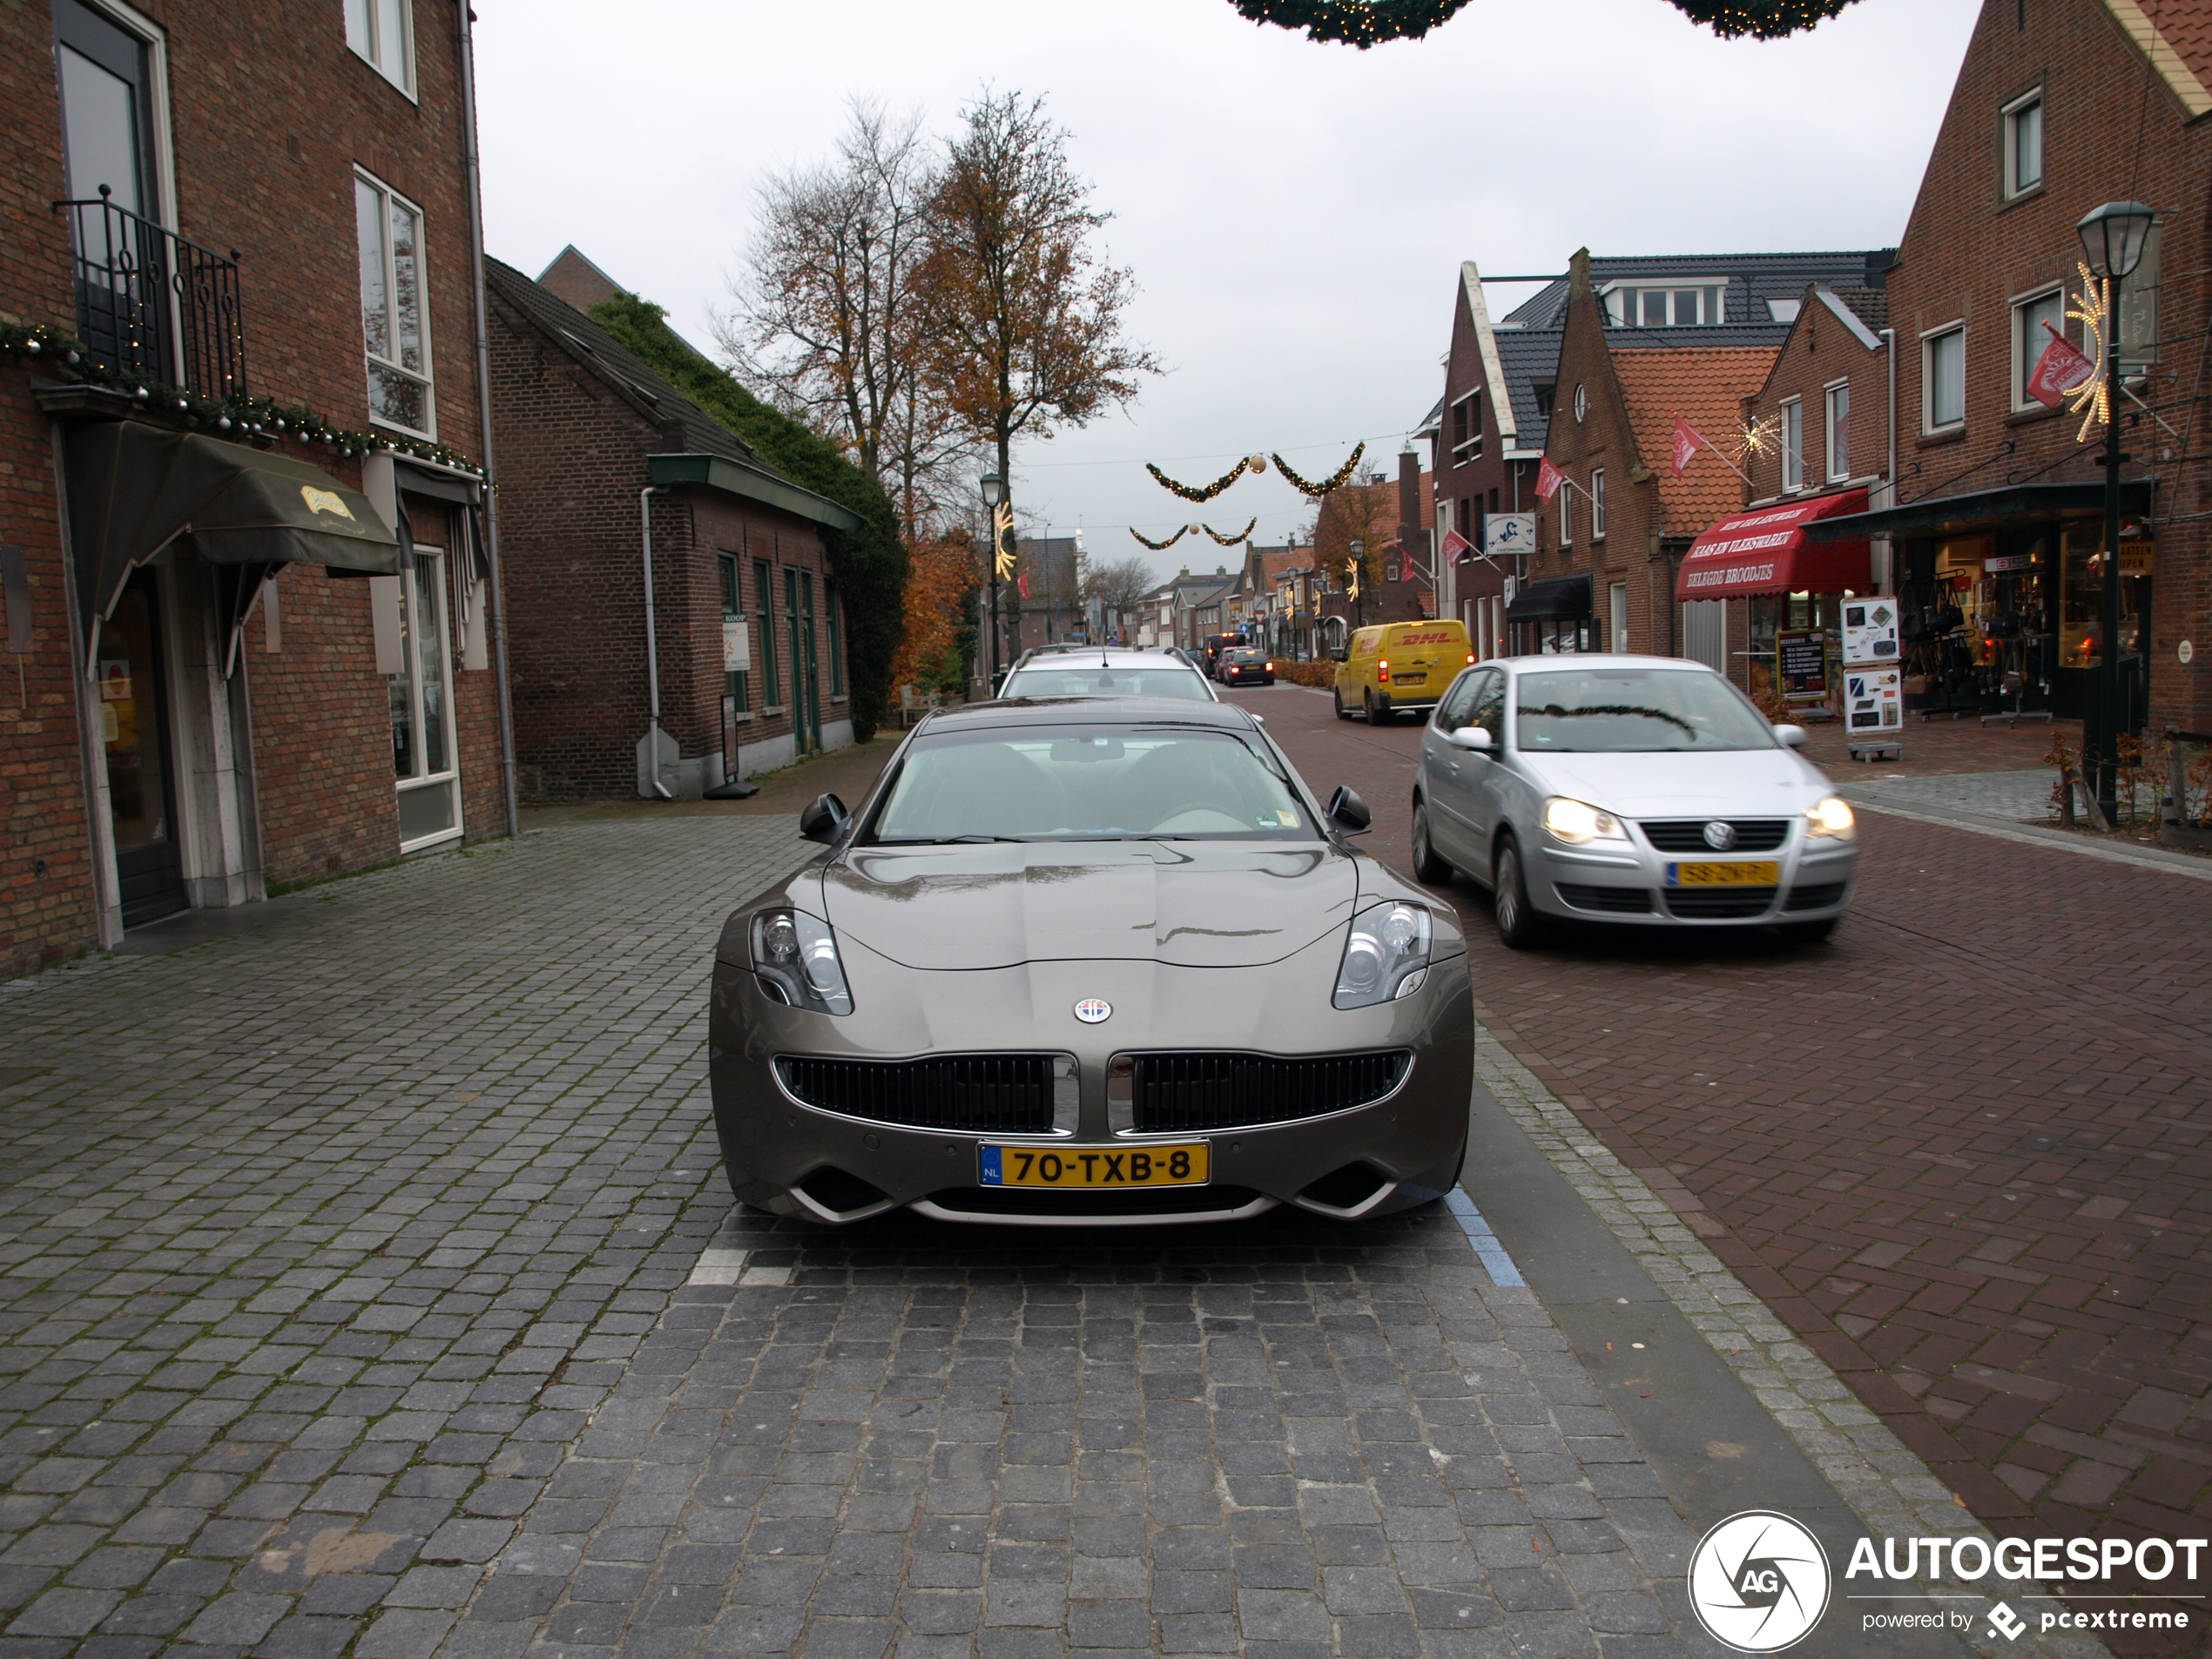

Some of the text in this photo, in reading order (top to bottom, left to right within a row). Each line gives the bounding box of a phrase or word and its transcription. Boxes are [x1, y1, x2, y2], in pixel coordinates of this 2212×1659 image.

[1690, 531, 1794, 558] KAAS EN VLEESWAREN
[2120, 545, 2152, 556] AATSEN
[2120, 558, 2144, 568] IJPEN
[1687, 563, 1774, 588] BELEGDE BROODJES
[1402, 632, 1452, 645] DHL
[984, 1168, 999, 1177] NL
[1014, 1150, 1190, 1182] 70-TXB-8
